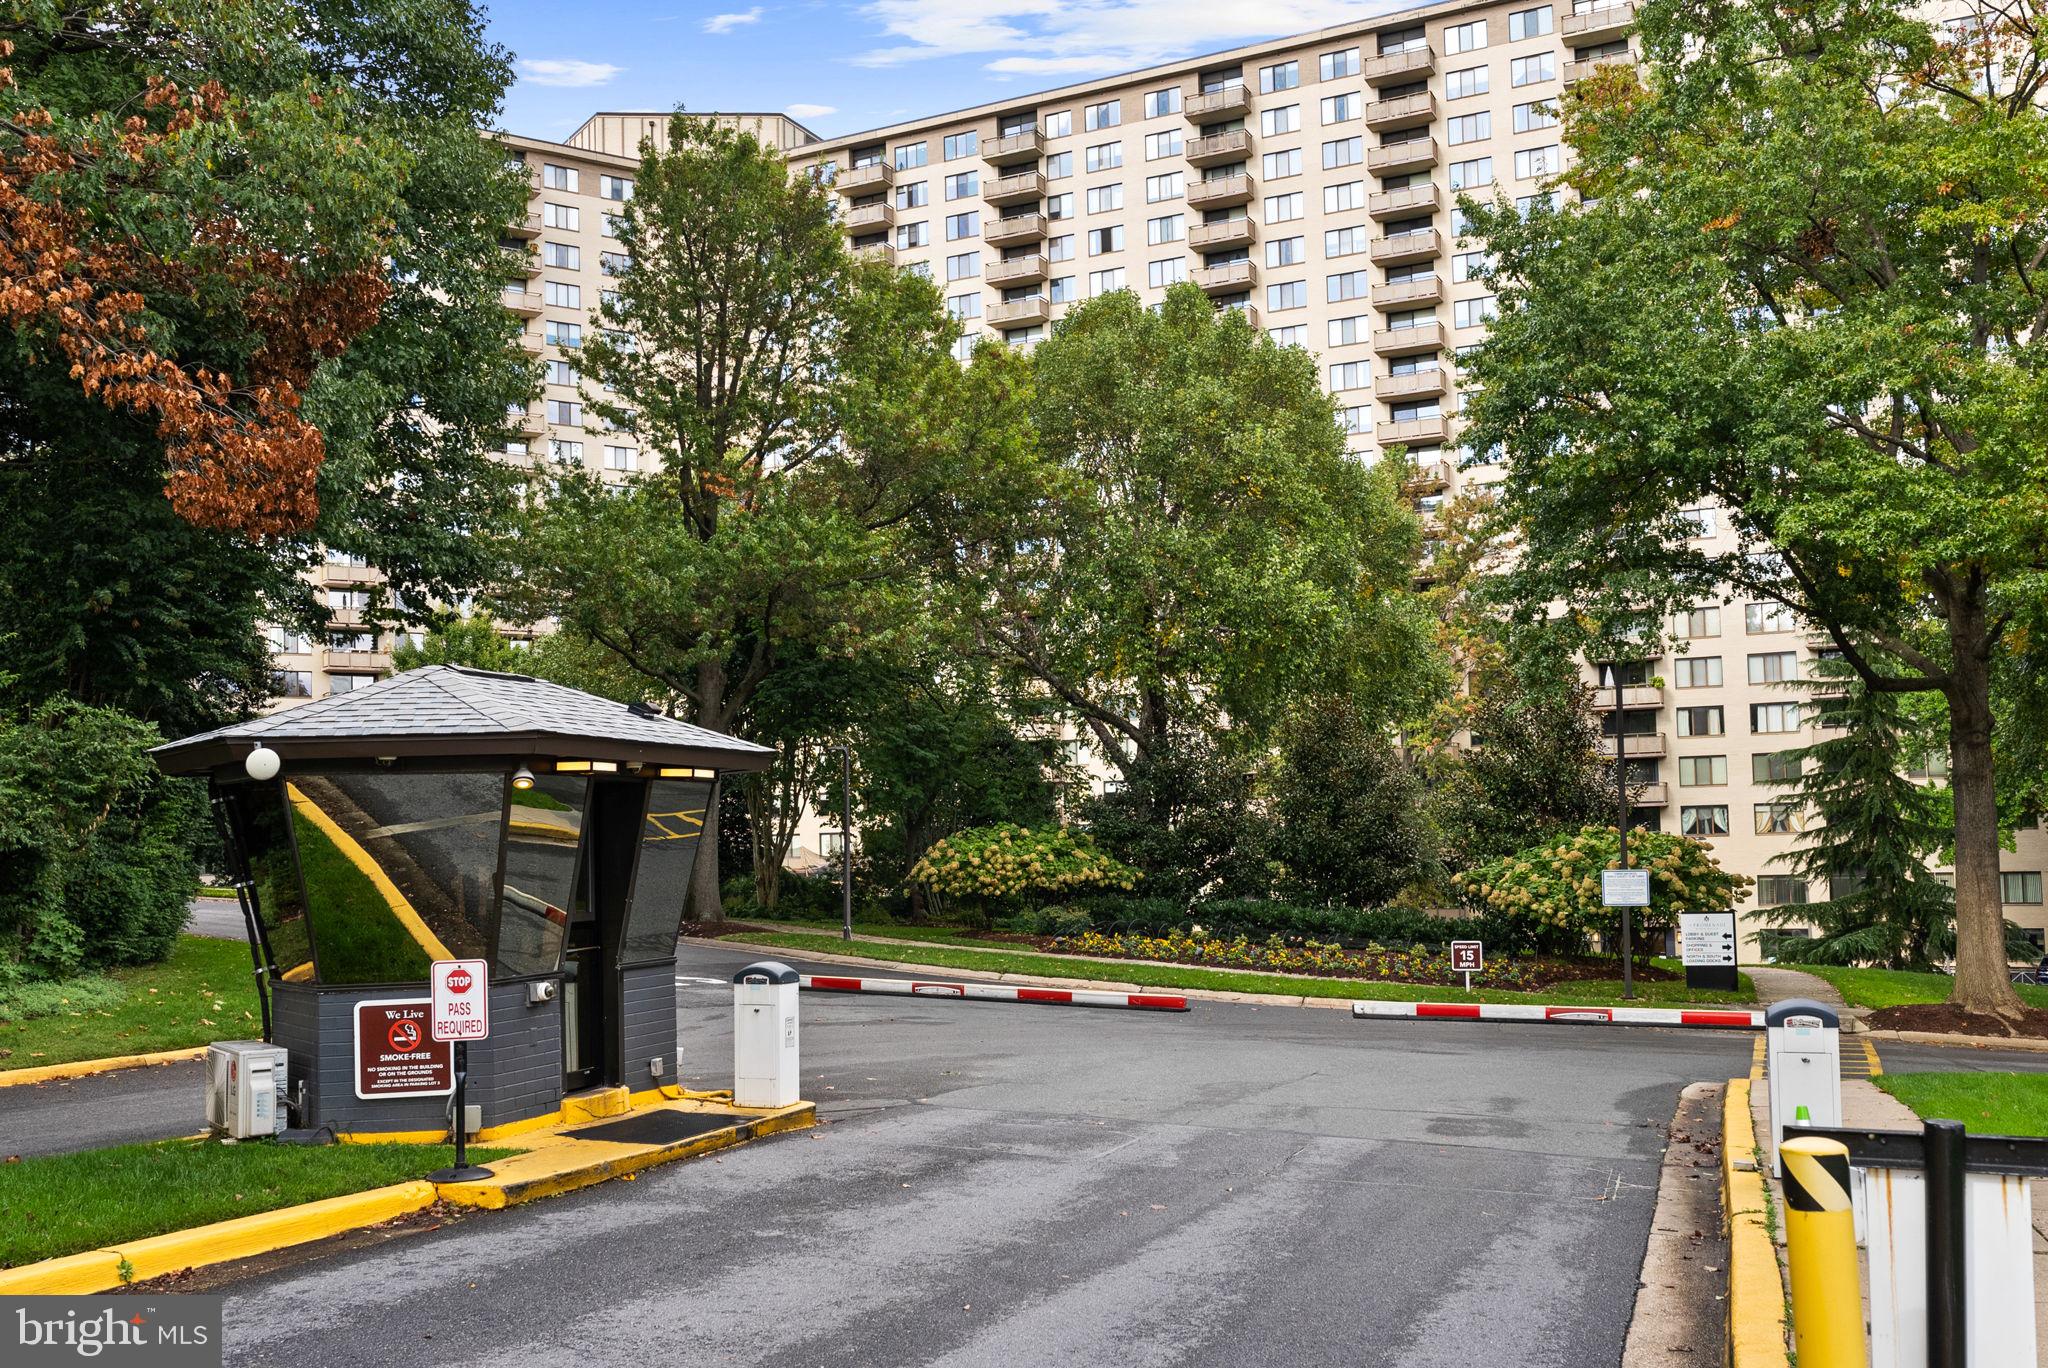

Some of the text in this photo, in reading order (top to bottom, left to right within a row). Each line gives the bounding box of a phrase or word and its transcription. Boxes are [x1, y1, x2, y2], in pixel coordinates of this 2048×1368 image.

[1460, 950, 1474, 960] 15
[447, 976, 471, 987] STOP
[448, 1002, 471, 1016] PASS
[385, 1010, 424, 1019] We Live
[437, 1020, 483, 1034] REQUIRED
[380, 1052, 431, 1061] SMOKE-FREE
